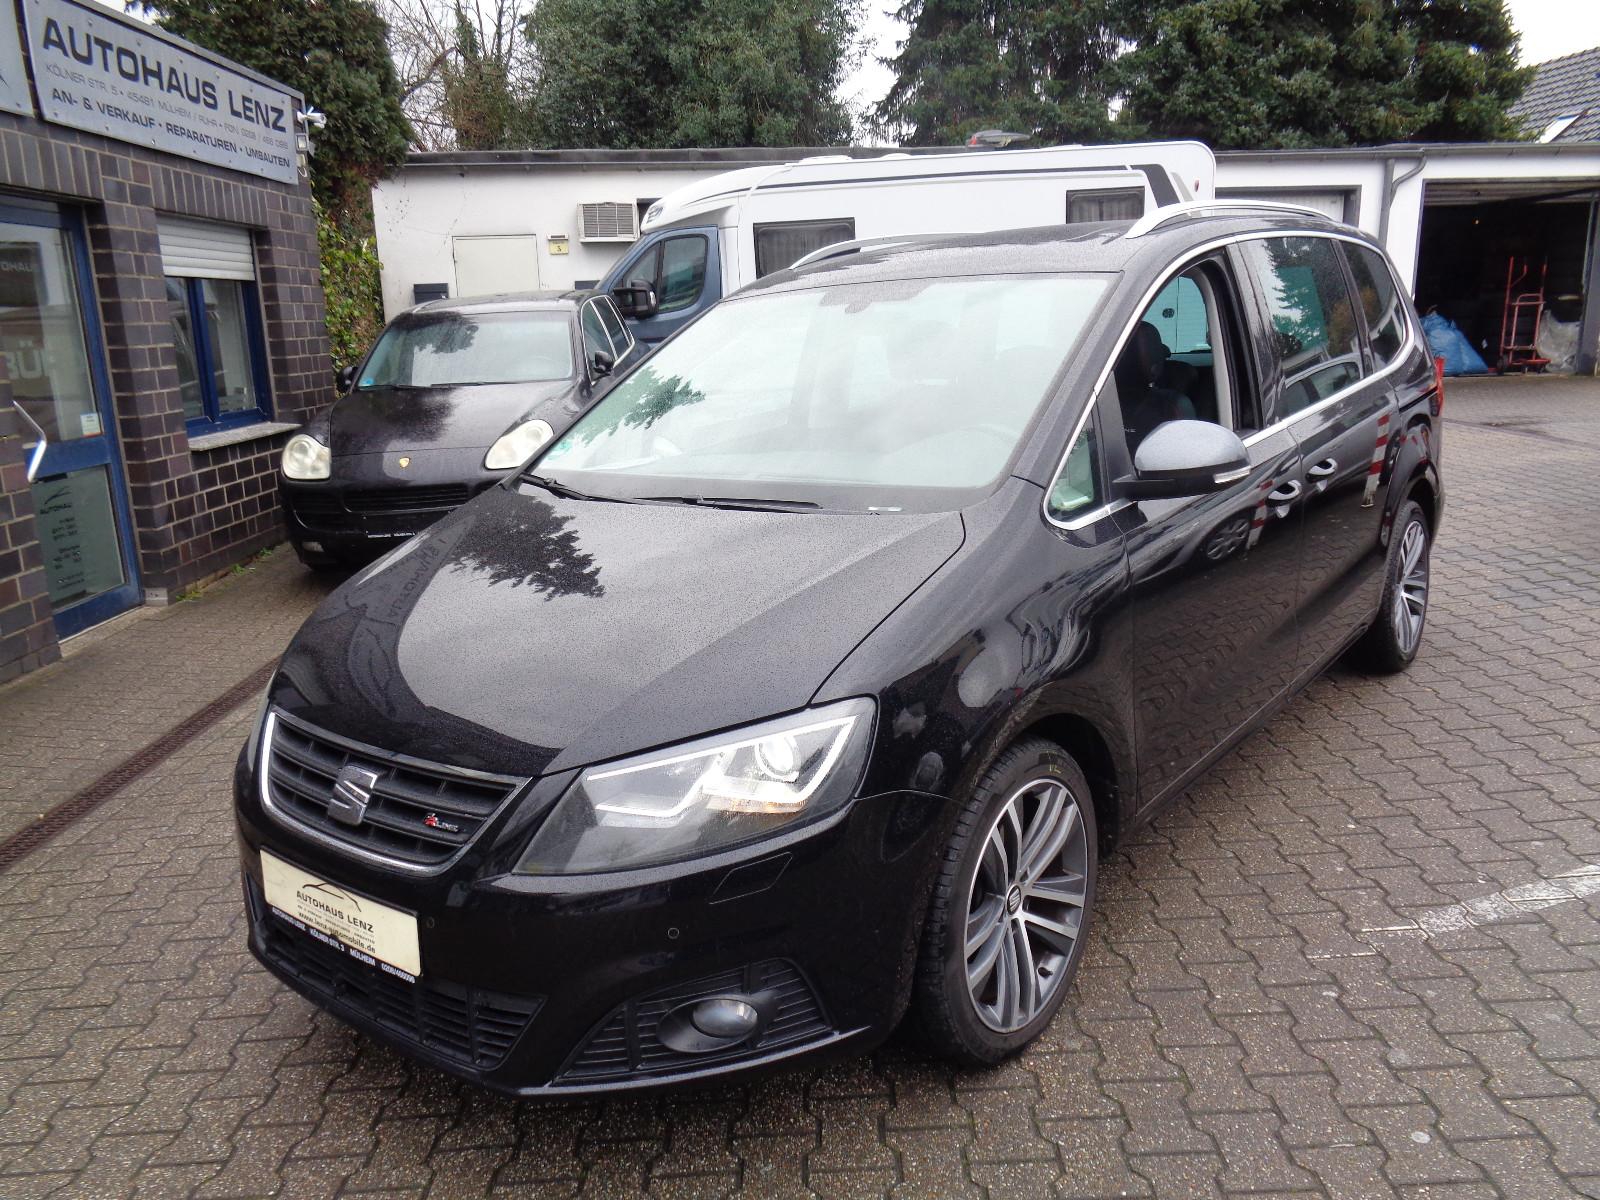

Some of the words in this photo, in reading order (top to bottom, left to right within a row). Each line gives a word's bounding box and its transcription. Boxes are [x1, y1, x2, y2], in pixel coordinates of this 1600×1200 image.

[43, 16, 219, 111] AUTOHAUS
[228, 89, 287, 133] LENZ
[52, 87, 78, 106] AN-
[82, 97, 94, 111] &
[96, 101, 155, 128] VERKAUF
[166, 122, 237, 153] REPARATUREN
[245, 146, 290, 168] UMBAUTEN
[296, 890, 344, 920] AUTOHAUS
[347, 913, 375, 933] LENZ
